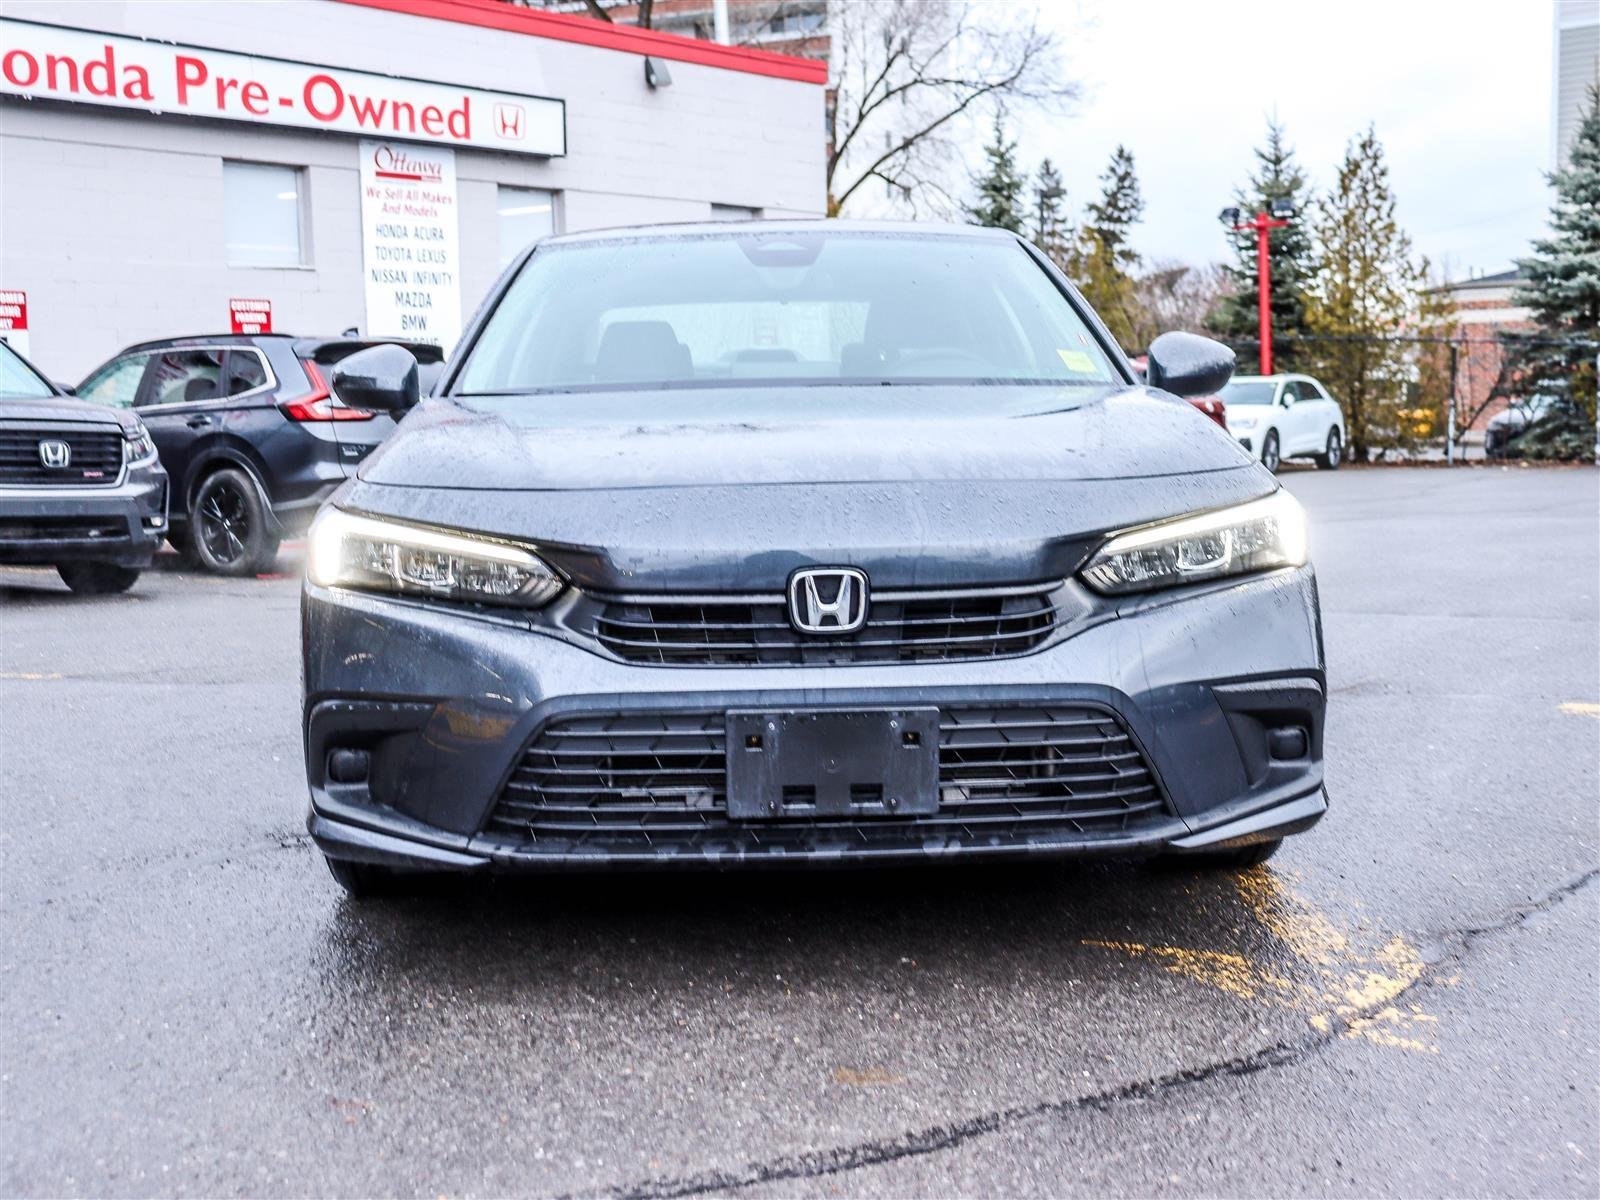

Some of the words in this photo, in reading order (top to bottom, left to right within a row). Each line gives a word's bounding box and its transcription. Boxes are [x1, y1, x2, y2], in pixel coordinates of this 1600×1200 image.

[176, 55, 471, 140] Pre-Owned
[374, 145, 442, 175] Ottawa
[366, 186, 381, 198] We
[384, 187, 402, 200] Sell
[406, 190, 419, 201] All
[423, 190, 452, 204] Makes
[383, 202, 401, 214] And
[404, 204, 438, 217] Models
[376, 223, 408, 239] HONDA
[414, 225, 444, 240] ACURA
[376, 246, 412, 261] TOYOTA
[417, 248, 446, 264] LEXUS
[371, 268, 407, 283] NISSAN
[413, 271, 452, 285] INFINITY
[395, 291, 432, 308] MAZDA
[402, 314, 427, 330] BMW
